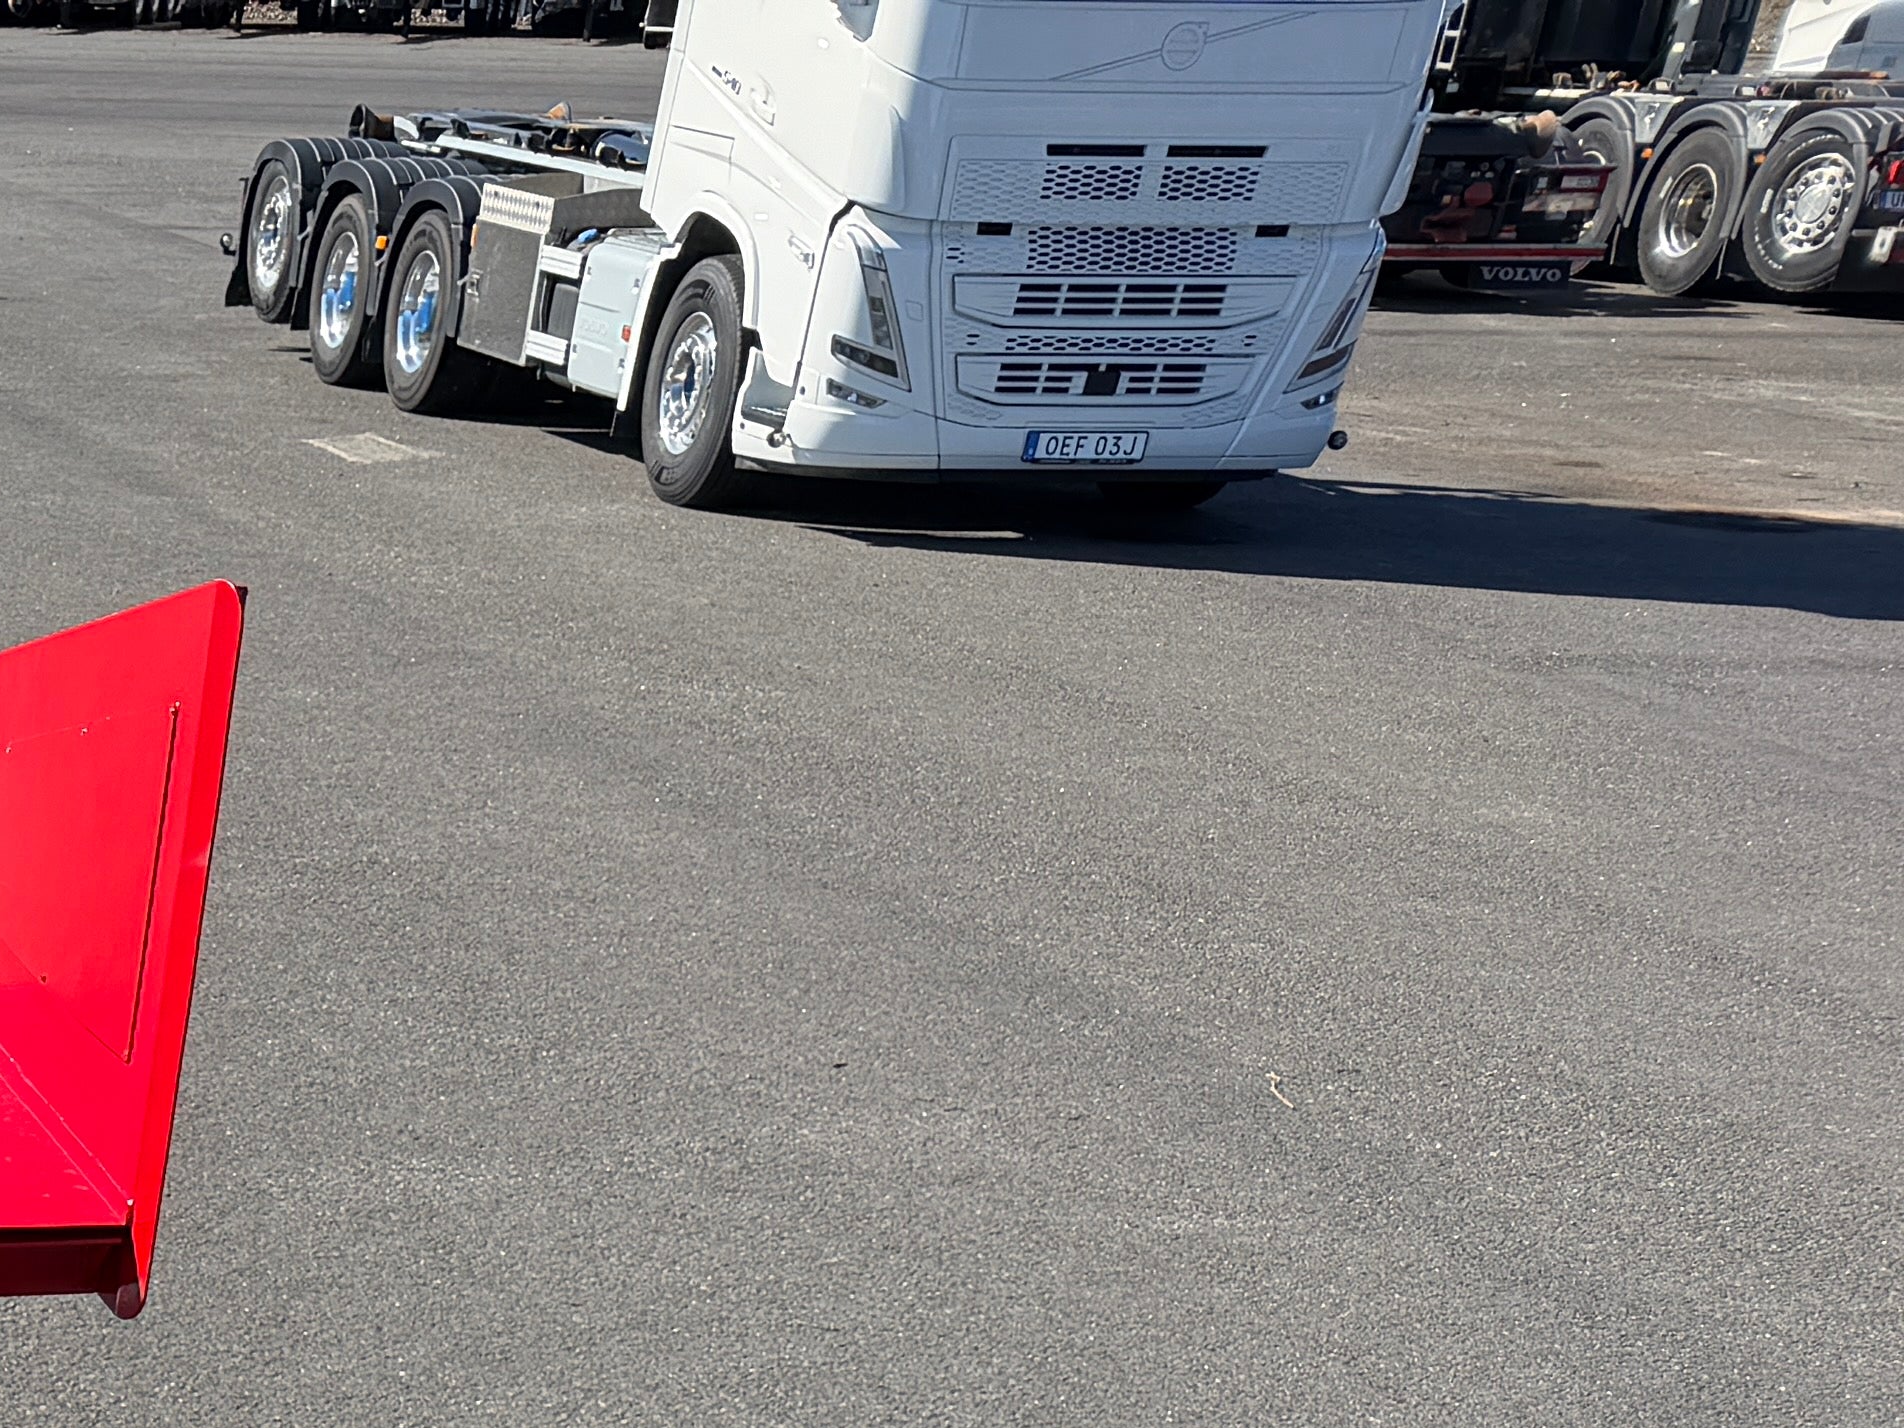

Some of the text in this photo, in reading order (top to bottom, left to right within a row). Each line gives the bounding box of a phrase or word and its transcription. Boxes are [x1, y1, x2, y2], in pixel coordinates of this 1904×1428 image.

[1479, 265, 1562, 282] VOLVO
[1045, 435, 1138, 456] OEF 03J
